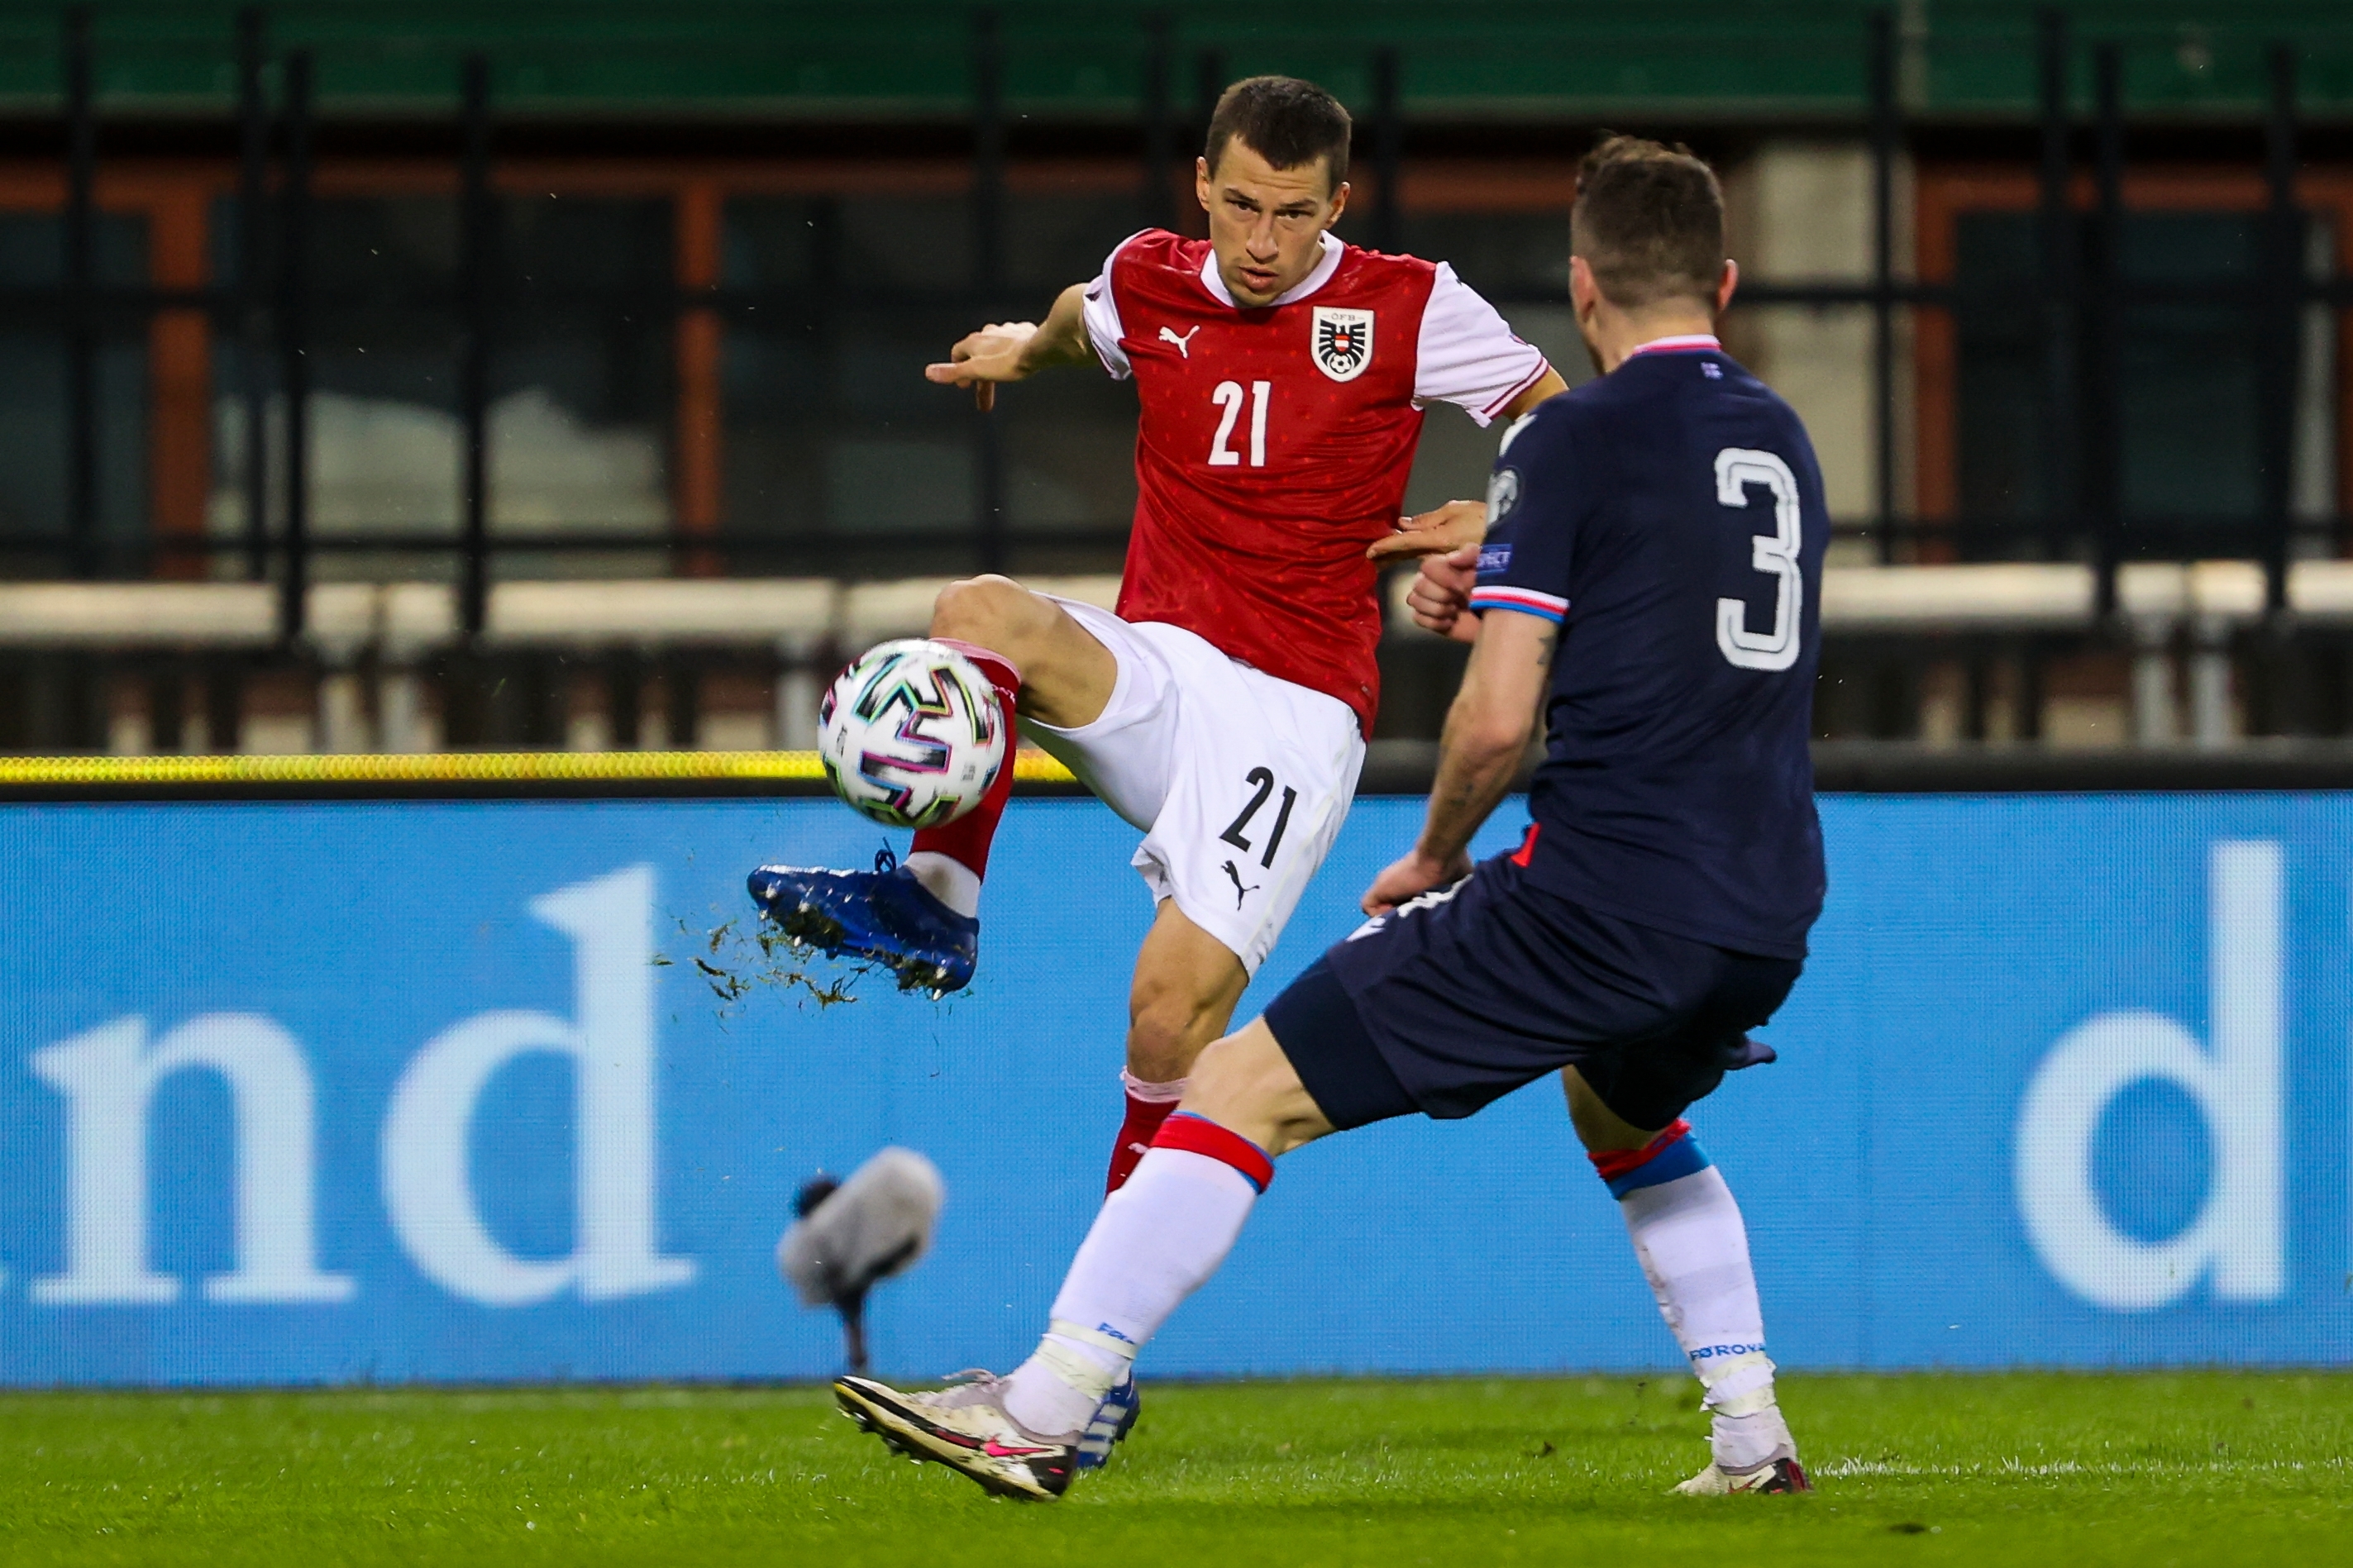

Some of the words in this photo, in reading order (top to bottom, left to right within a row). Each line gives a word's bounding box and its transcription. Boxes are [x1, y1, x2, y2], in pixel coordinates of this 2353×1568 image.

[1208, 380, 1272, 467] 21
[1714, 447, 1802, 672] 3
[1219, 766, 1297, 870] 21
[0, 860, 699, 1307] nd
[2013, 839, 2286, 1313] d
